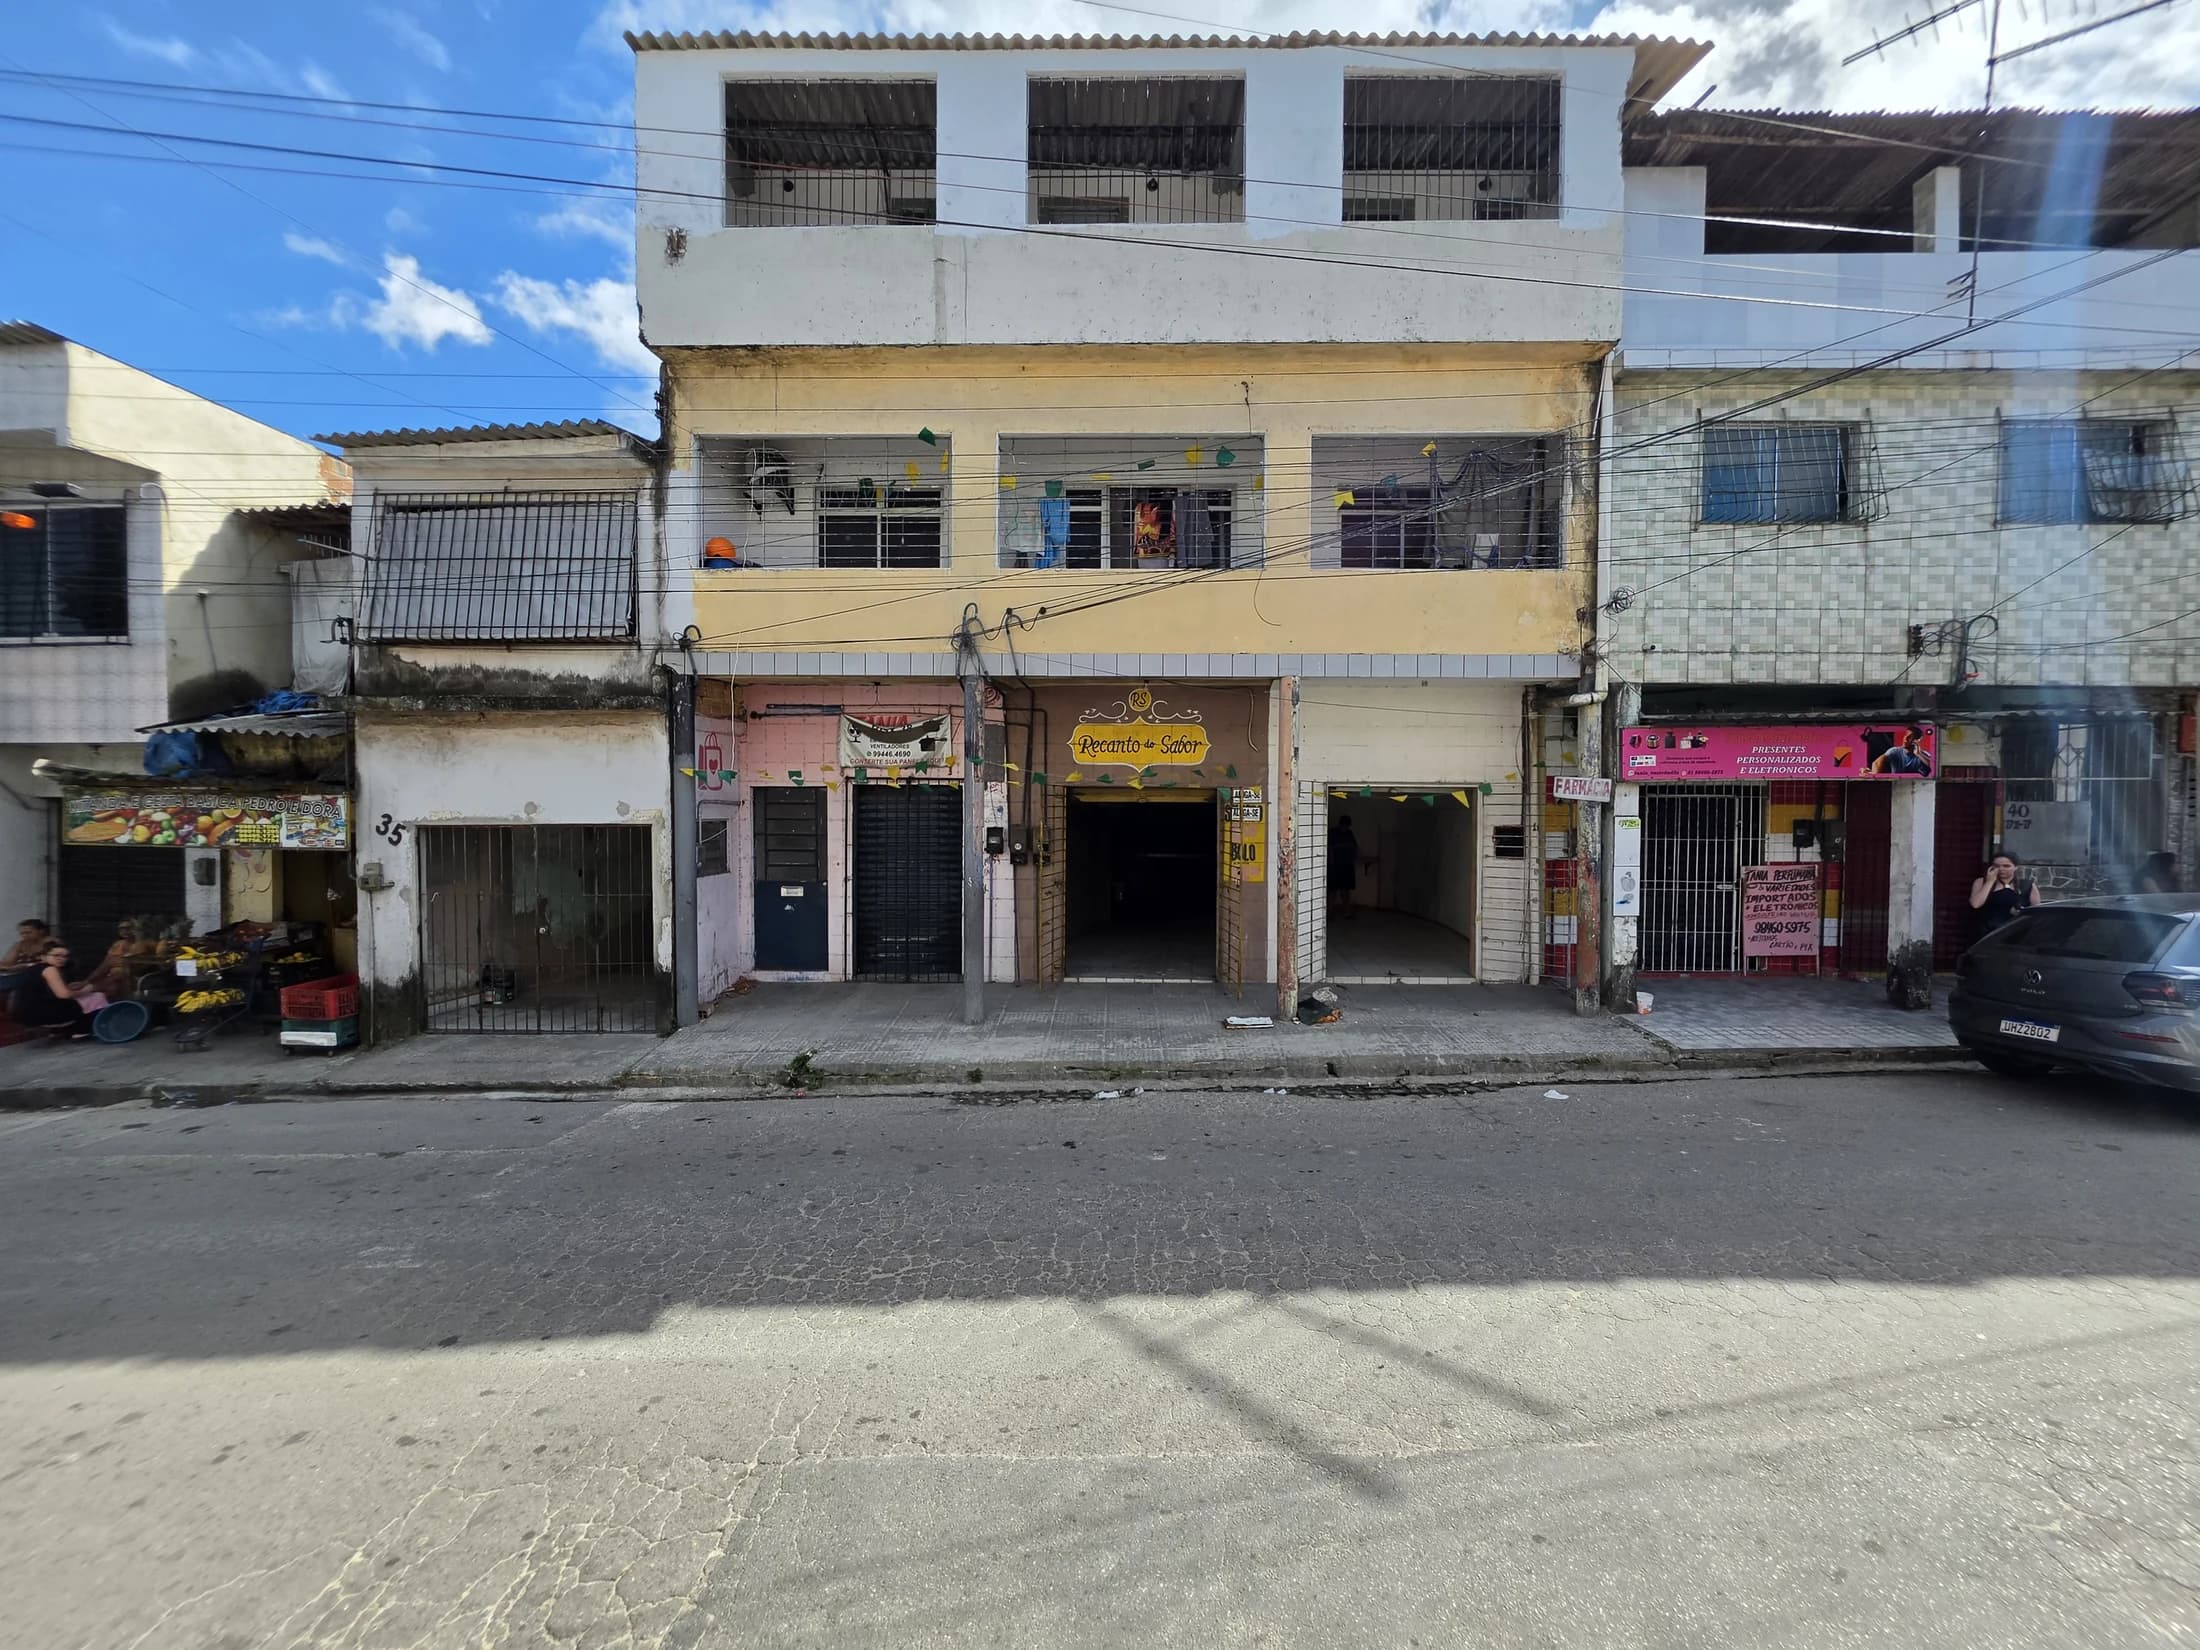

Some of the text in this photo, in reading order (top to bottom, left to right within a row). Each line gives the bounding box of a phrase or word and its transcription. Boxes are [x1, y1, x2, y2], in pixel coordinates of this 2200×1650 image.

[1131, 691, 1147, 708] RS
[1078, 734, 1203, 758] Recanto do Sabor
[1752, 745, 1807, 754] PRESENTES
[1736, 755, 1822, 764] PERSONALIZADOS
[1740, 766, 1818, 774] E ELETRONICOS
[240, 798, 287, 813] PEDRO
[288, 800, 300, 814] E
[301, 801, 341, 818] DORA
[375, 813, 407, 847] 35
[1744, 892, 1817, 904] IMPORTADOS
[1752, 901, 1818, 913] ELETRONICOS
